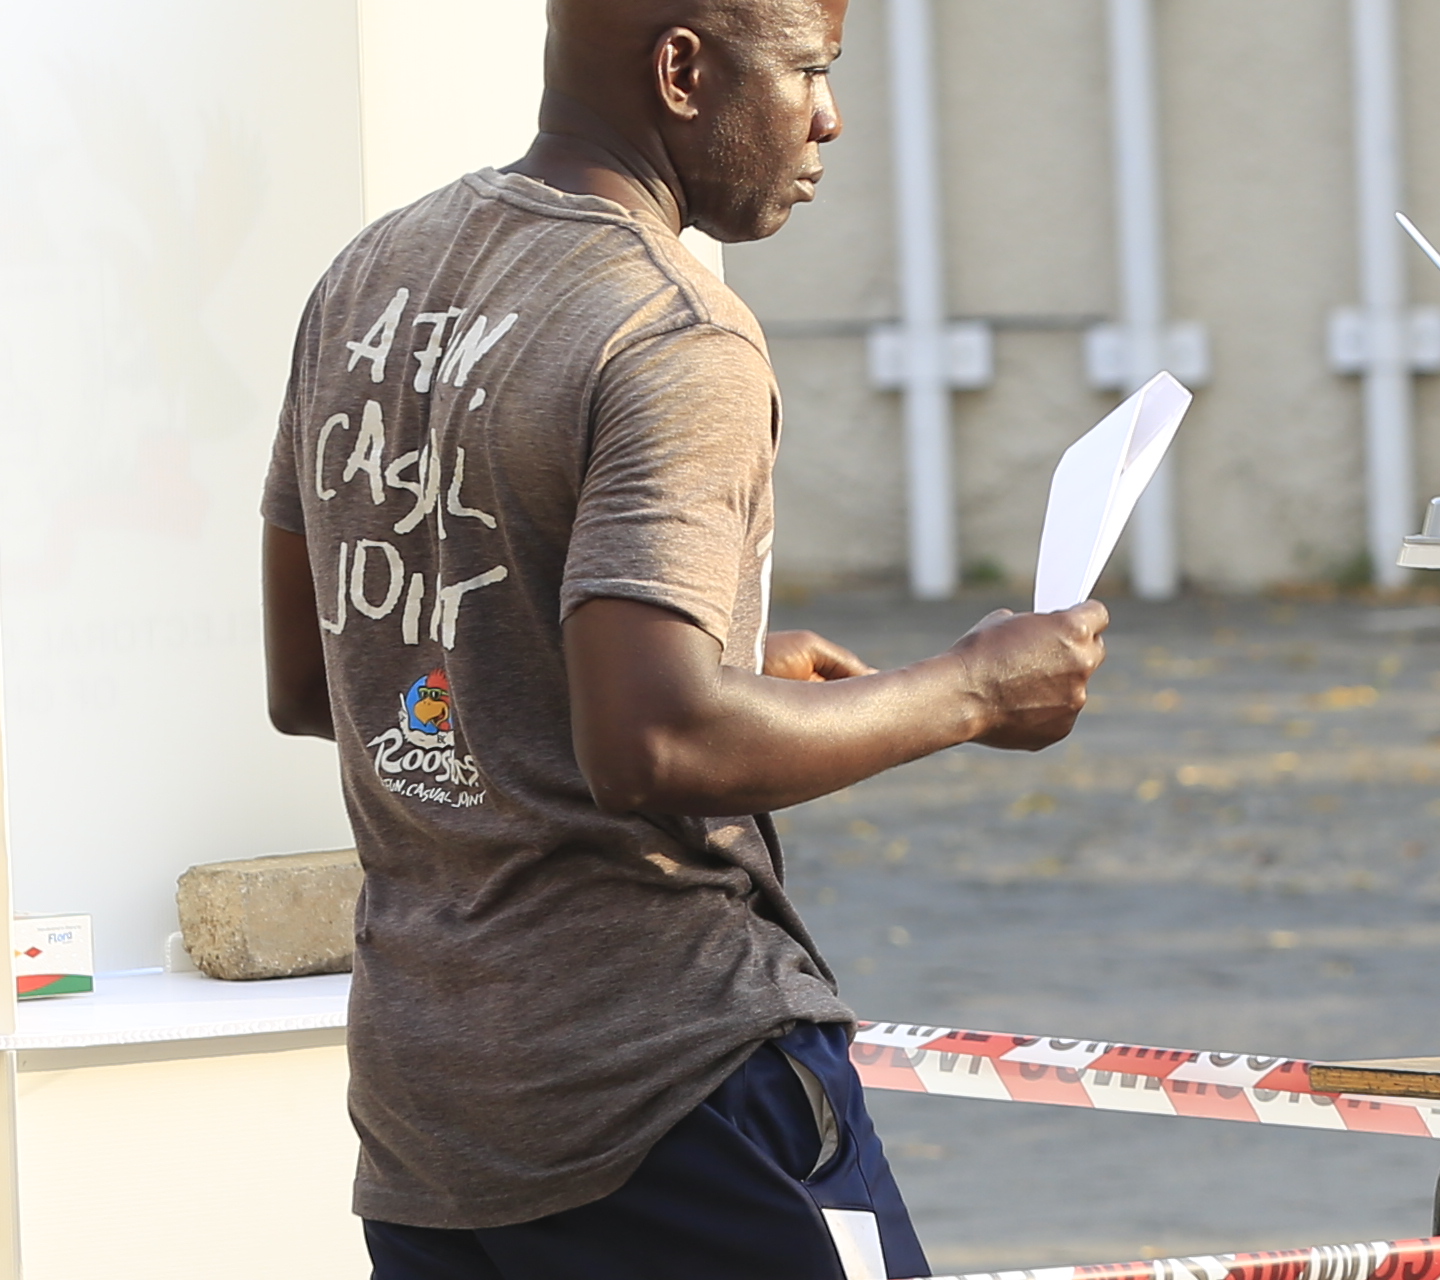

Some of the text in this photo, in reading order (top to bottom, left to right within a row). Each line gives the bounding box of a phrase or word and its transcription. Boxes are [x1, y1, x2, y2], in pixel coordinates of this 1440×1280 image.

[346, 287, 409, 383] A
[406, 782, 452, 804] CASUAL
[451, 789, 487, 808] JOINT
